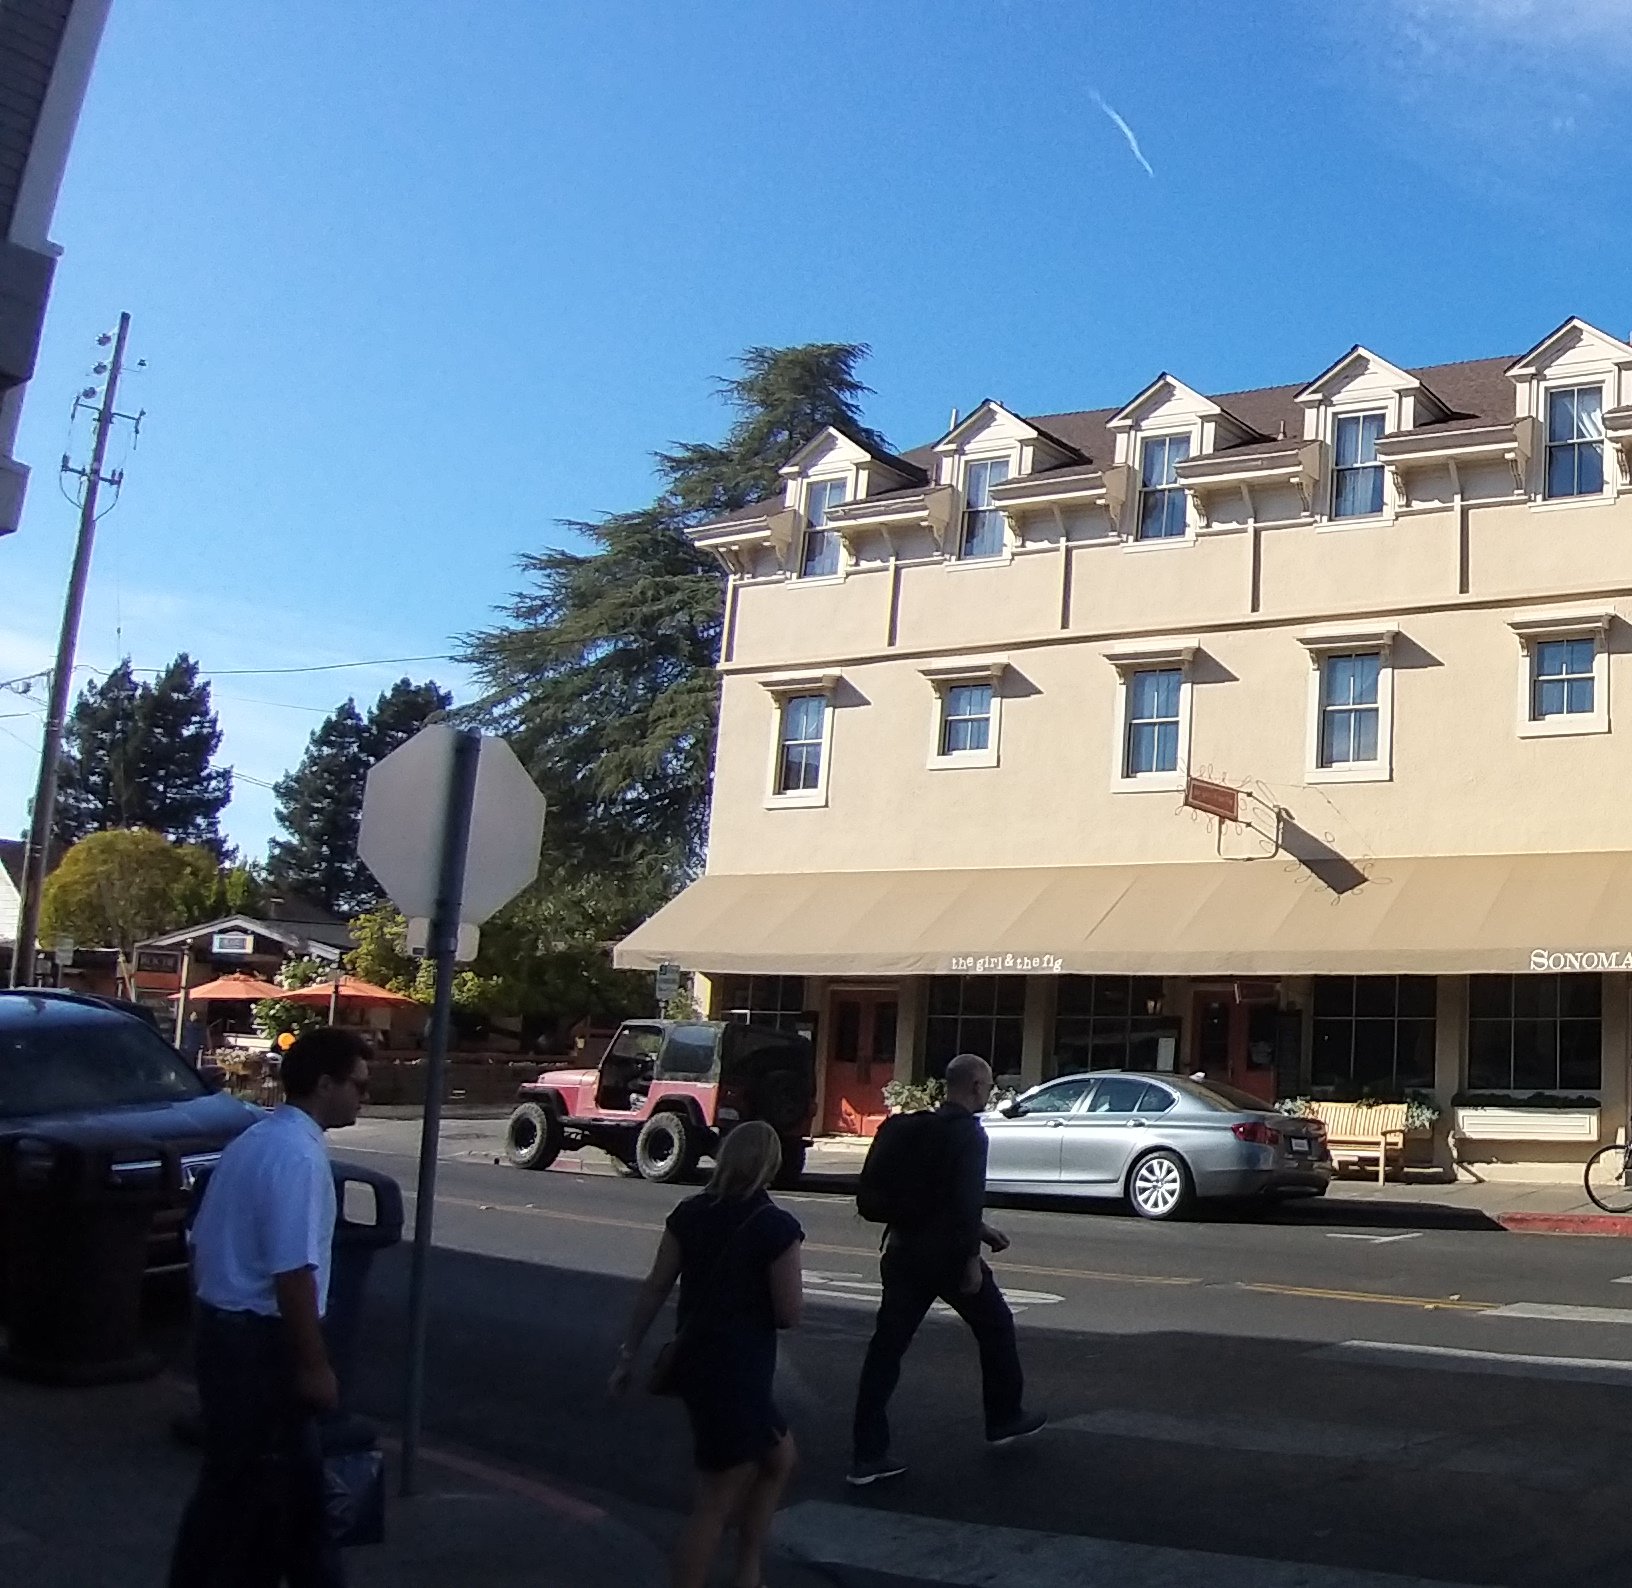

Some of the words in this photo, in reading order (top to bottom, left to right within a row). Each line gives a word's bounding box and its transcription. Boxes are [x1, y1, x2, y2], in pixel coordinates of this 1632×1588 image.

[952, 956, 974, 969] the
[976, 956, 1002, 971] girl
[1004, 953, 1014, 967] &
[1016, 957, 1040, 969] the
[1042, 954, 1063, 973] fig
